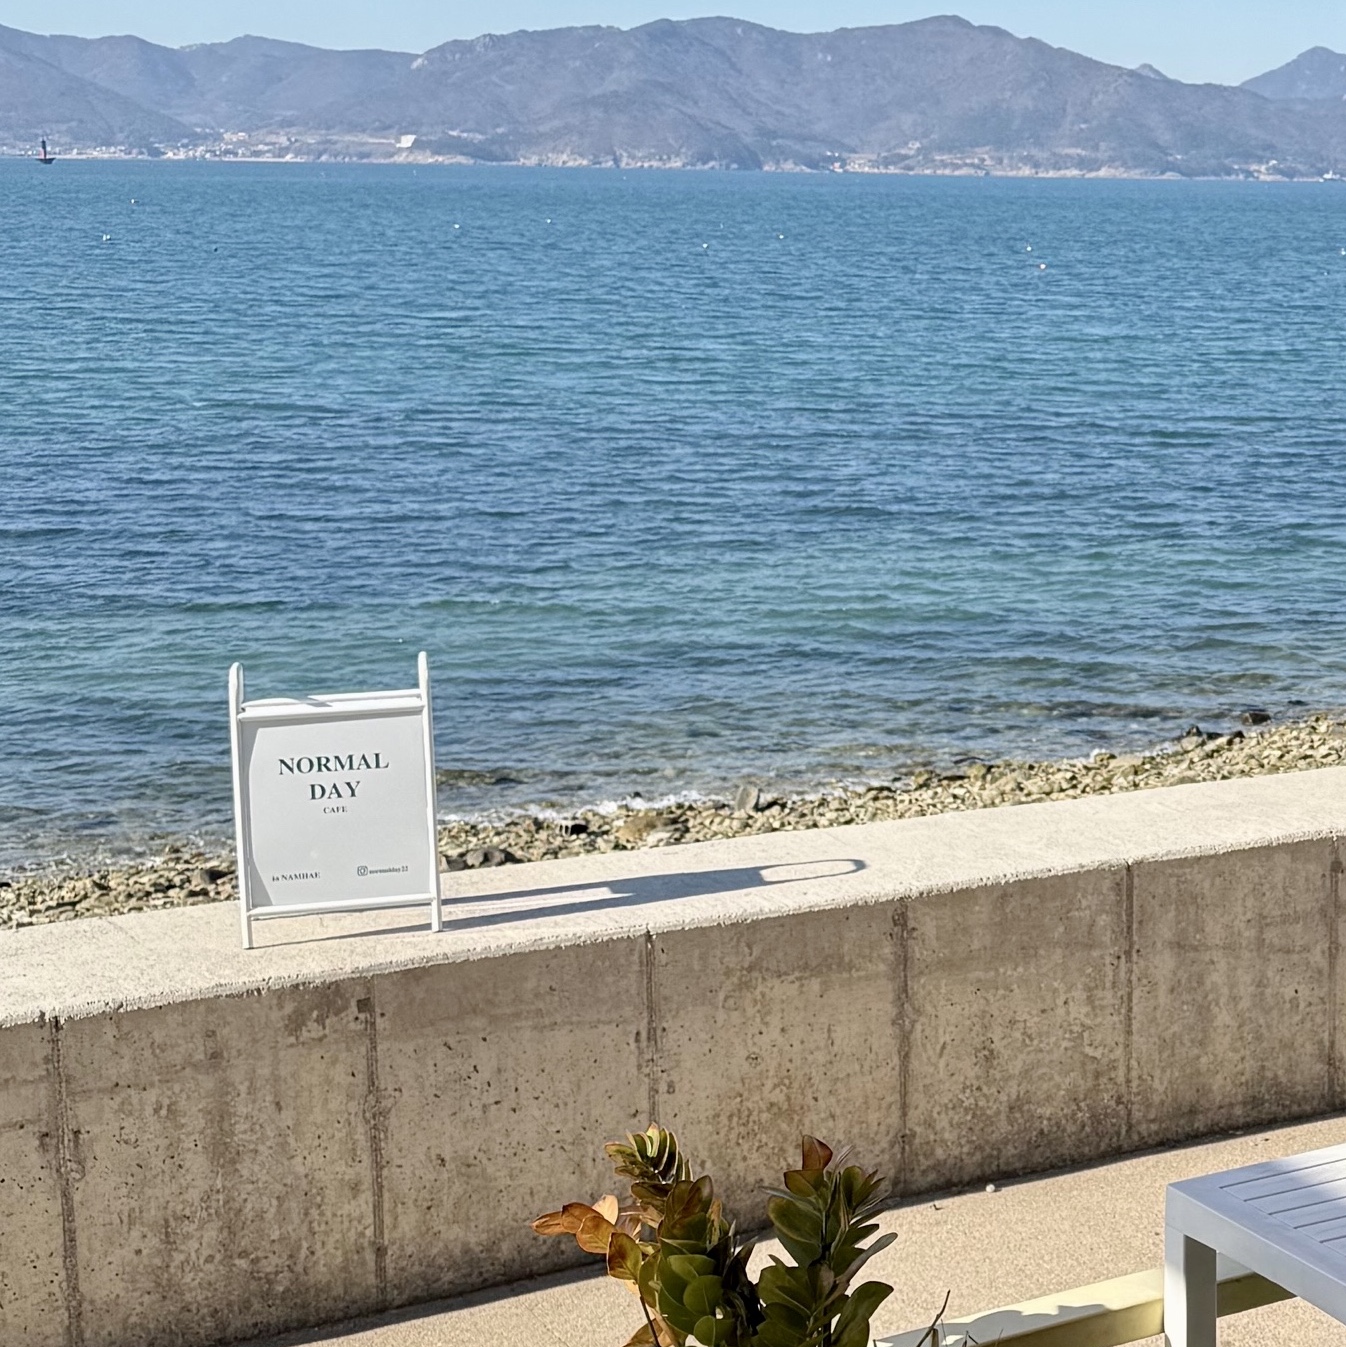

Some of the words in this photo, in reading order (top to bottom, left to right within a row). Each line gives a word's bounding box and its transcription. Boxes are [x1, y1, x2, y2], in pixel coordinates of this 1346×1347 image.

[278, 752, 390, 775] NORMAL
[309, 780, 361, 800] DAY
[322, 805, 348, 814] CAFE
